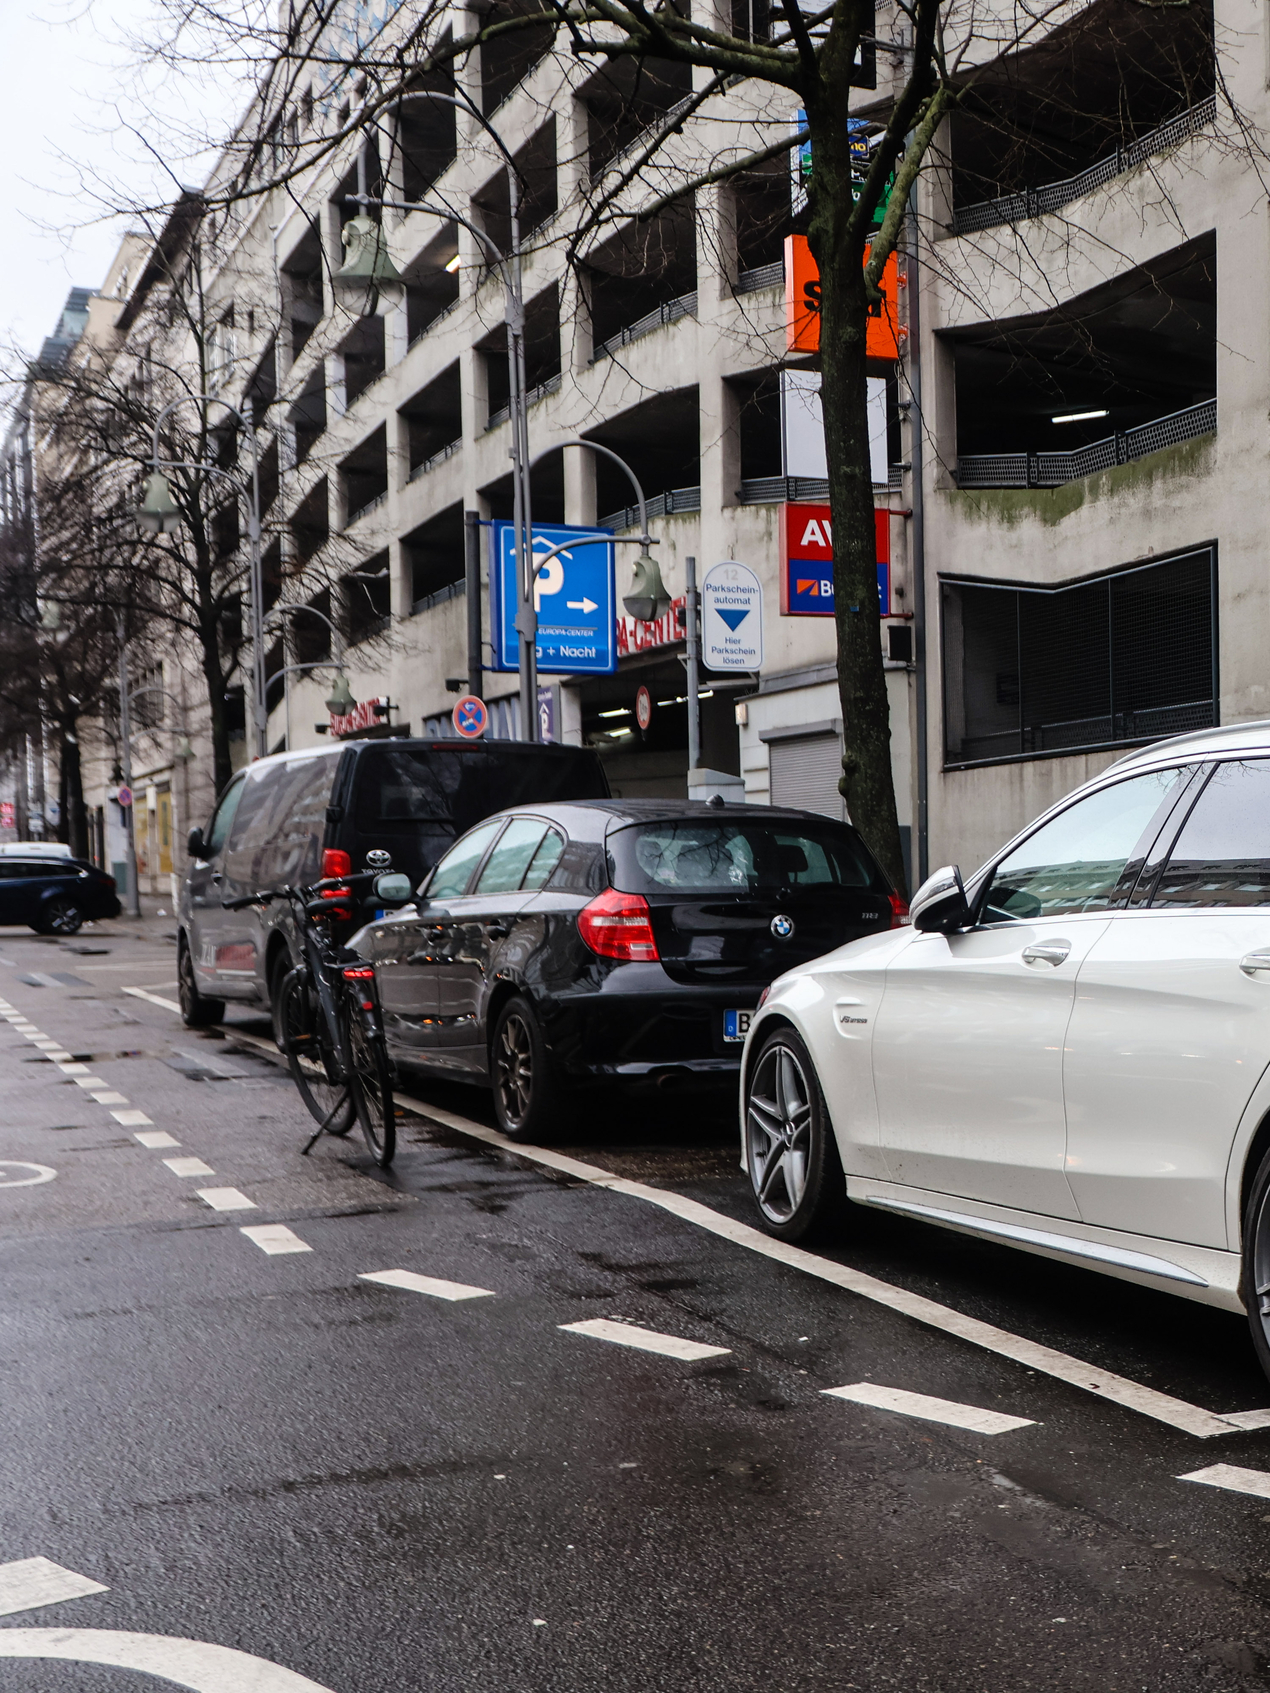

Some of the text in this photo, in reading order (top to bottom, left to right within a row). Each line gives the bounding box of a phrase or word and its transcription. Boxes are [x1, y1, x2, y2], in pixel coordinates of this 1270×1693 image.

[723, 569, 739, 581] 12
[705, 583, 759, 594] Parkschein-
[713, 596, 751, 604] automat
[724, 636, 741, 644] Hier
[560, 645, 596, 658] Nacht
[711, 646, 756, 655] Parkschein
[722, 656, 745, 665] lösen
[738, 1013, 750, 1033] B
